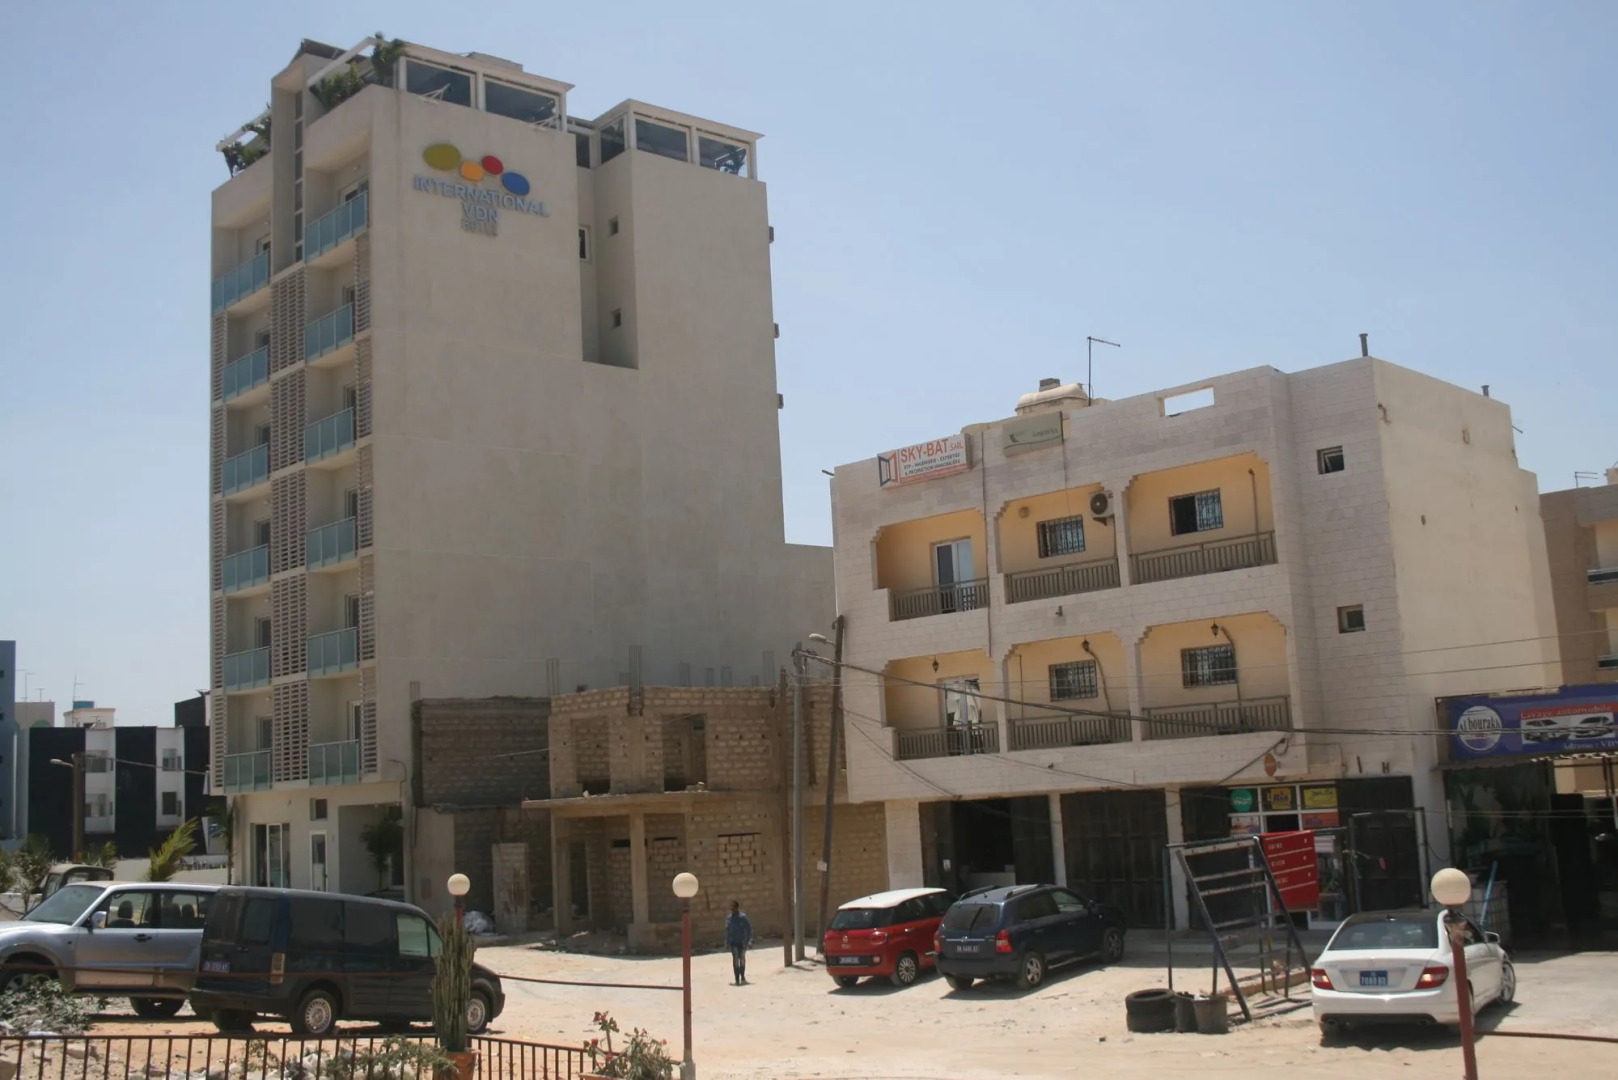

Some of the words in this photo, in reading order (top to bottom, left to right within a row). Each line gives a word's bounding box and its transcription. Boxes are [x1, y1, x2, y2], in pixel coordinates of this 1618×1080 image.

[413, 175, 549, 217] INTERNATIONAL
[462, 203, 499, 223] VDN
[900, 438, 948, 463] SKY-BAT
[1557, 704, 1612, 716] automobile
